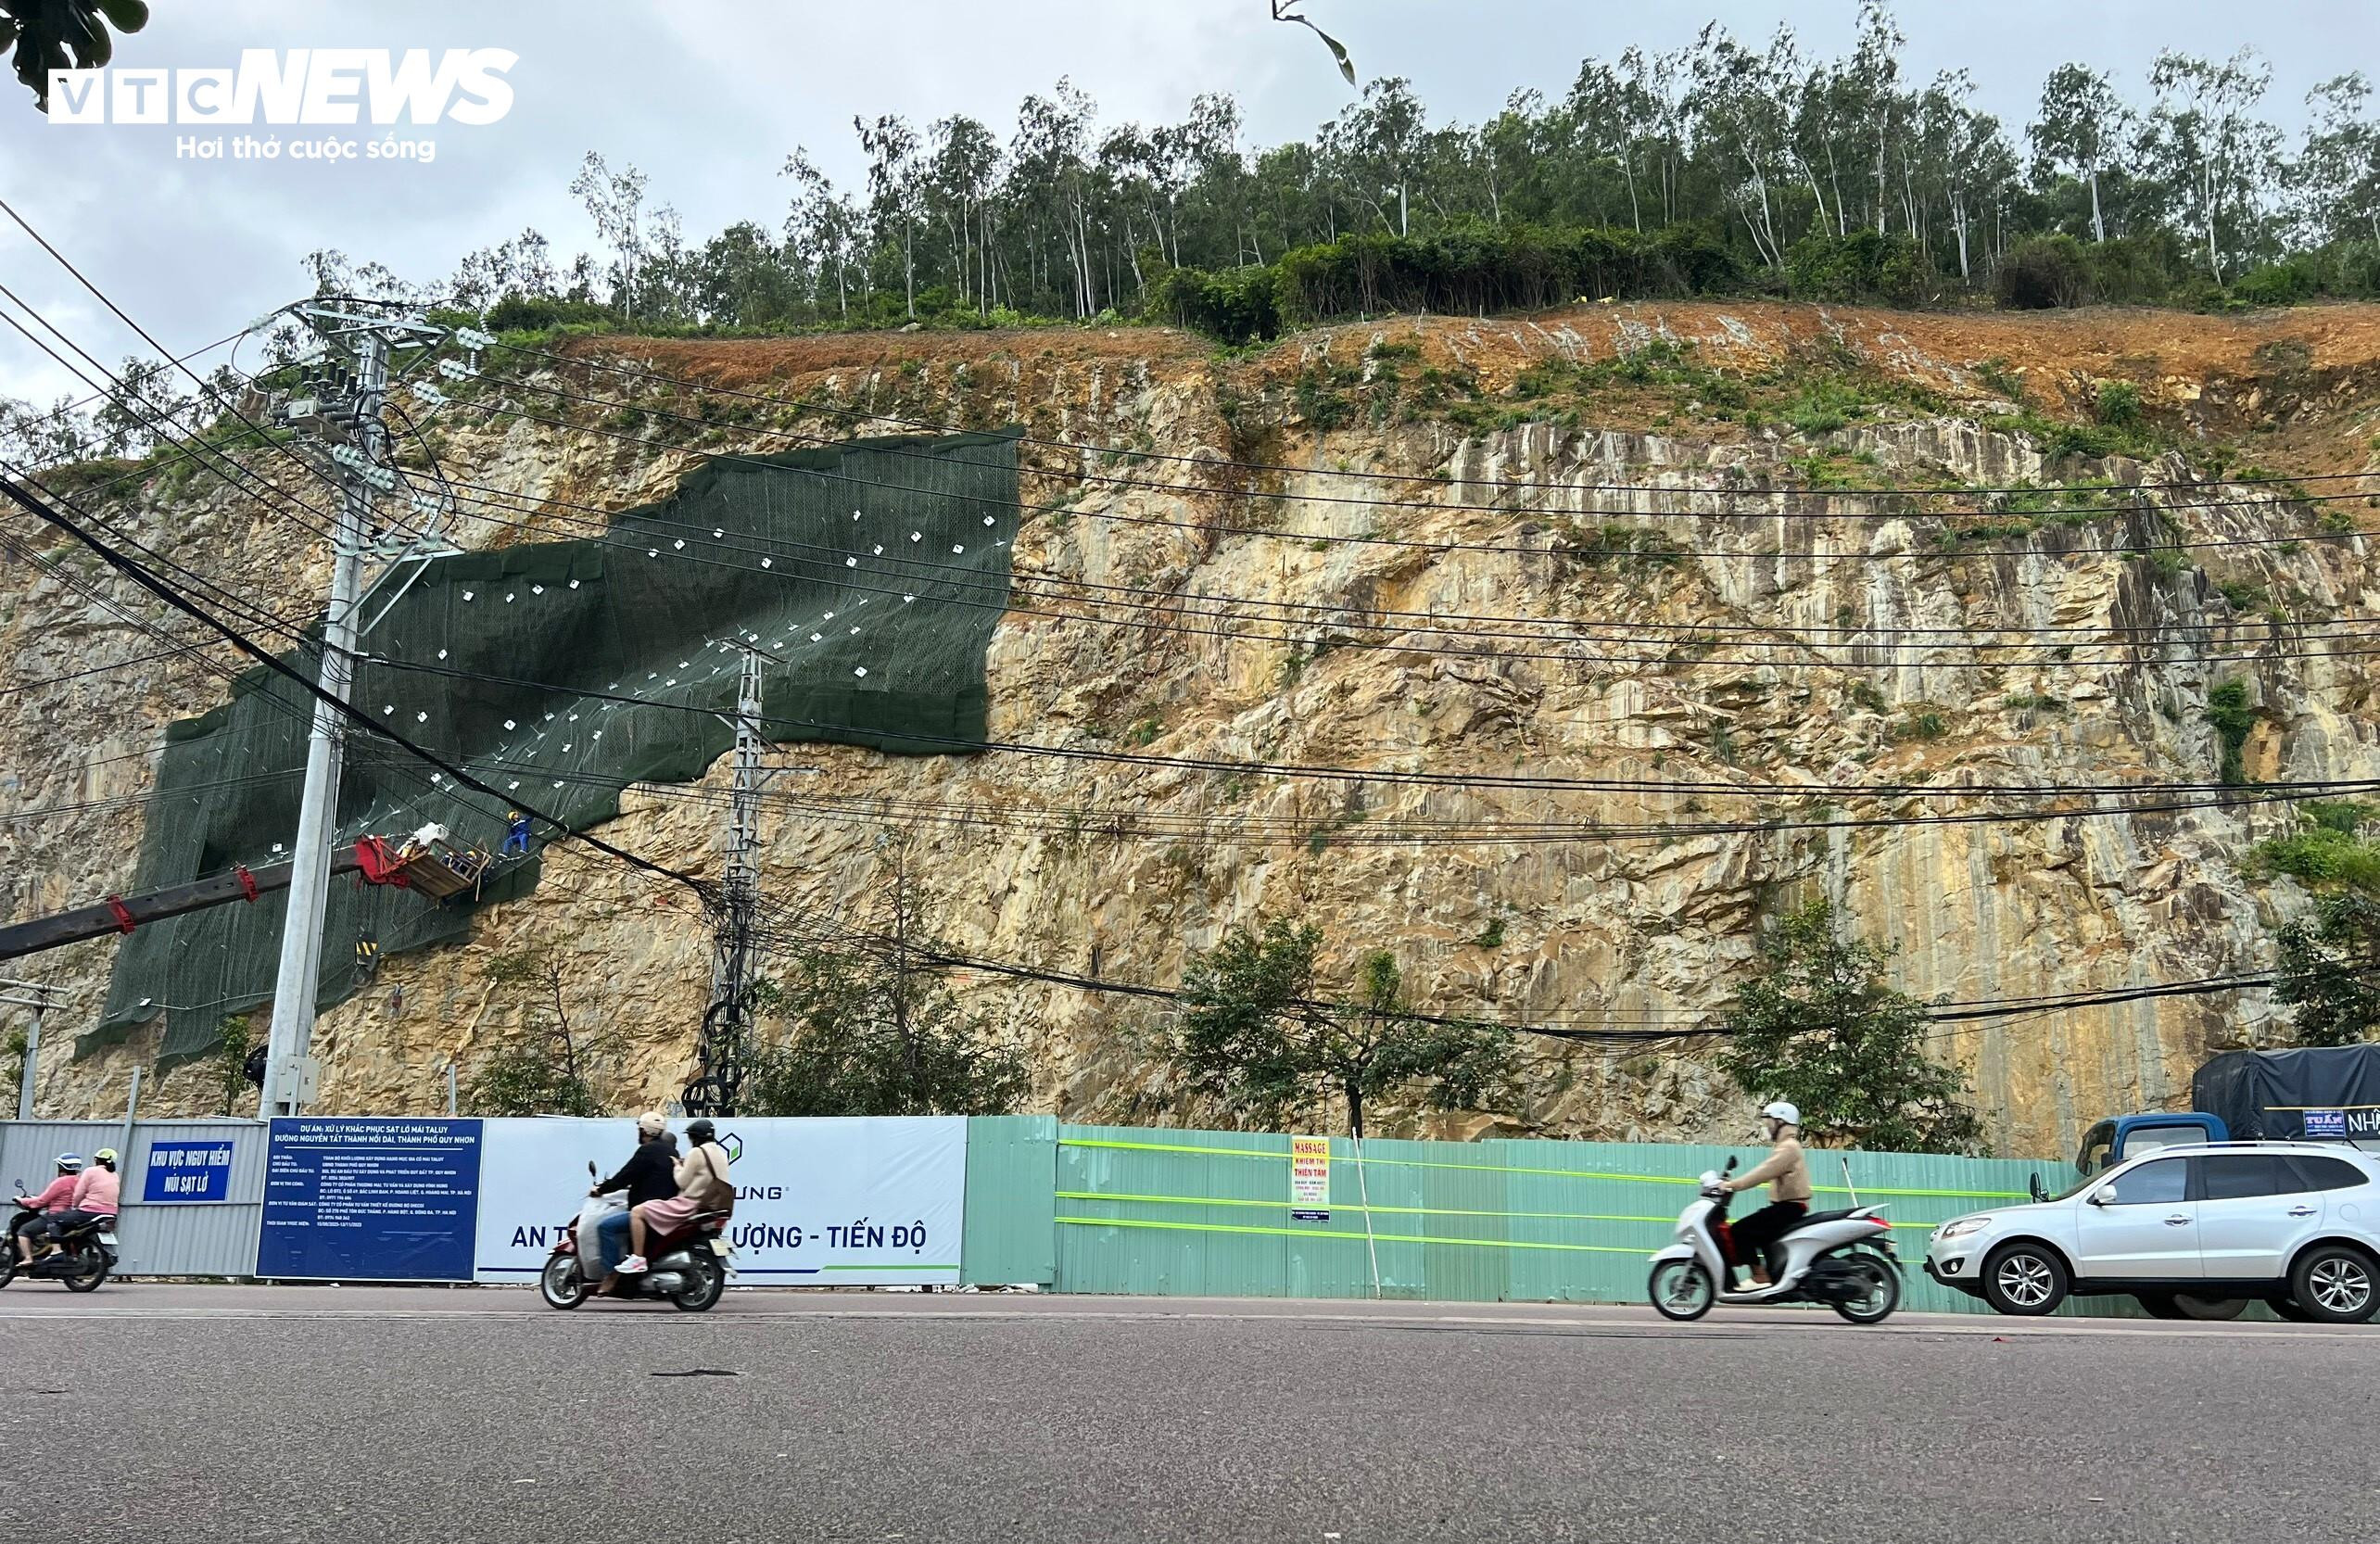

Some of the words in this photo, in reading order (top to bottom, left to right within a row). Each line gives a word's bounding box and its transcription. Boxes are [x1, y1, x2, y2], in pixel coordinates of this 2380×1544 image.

[150, 1151, 168, 1167] KHU
[168, 1149, 185, 1170] VỰC
[185, 1150, 209, 1167] NGUY
[209, 1144, 231, 1166] HIỂM
[1294, 1143, 1326, 1154] MASSAGE
[164, 1173, 180, 1192] NÚI
[180, 1176, 198, 1196] SẠT
[197, 1171, 209, 1192] LỞ
[733, 1185, 783, 1200] ƯNG
[511, 1226, 546, 1247] AN
[731, 1222, 803, 1255] ƯỢNG
[827, 1217, 885, 1247] TIẾN
[892, 1220, 927, 1255] ĐỘ
